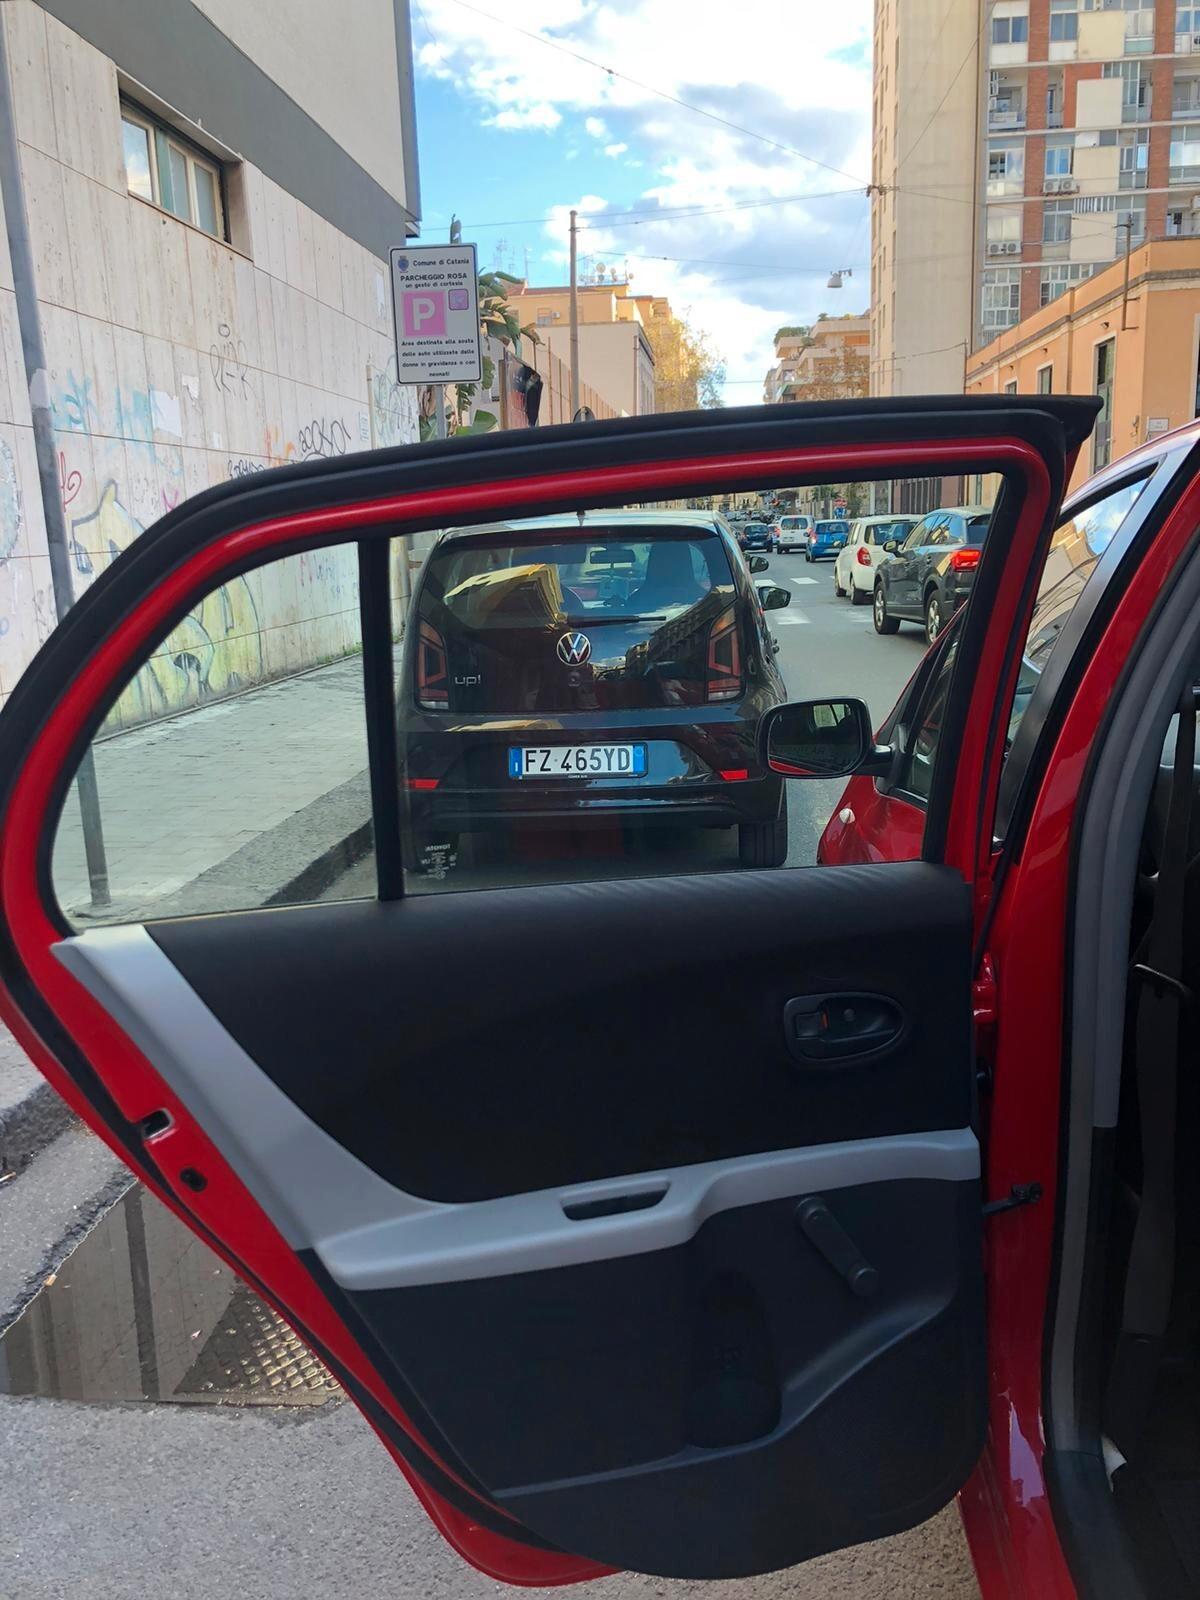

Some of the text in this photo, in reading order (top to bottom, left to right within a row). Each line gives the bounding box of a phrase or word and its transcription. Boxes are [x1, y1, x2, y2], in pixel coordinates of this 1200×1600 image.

[413, 298, 435, 331] P
[454, 674, 481, 686] up!
[525, 749, 552, 772] FZ
[560, 748, 630, 772] 465YD
